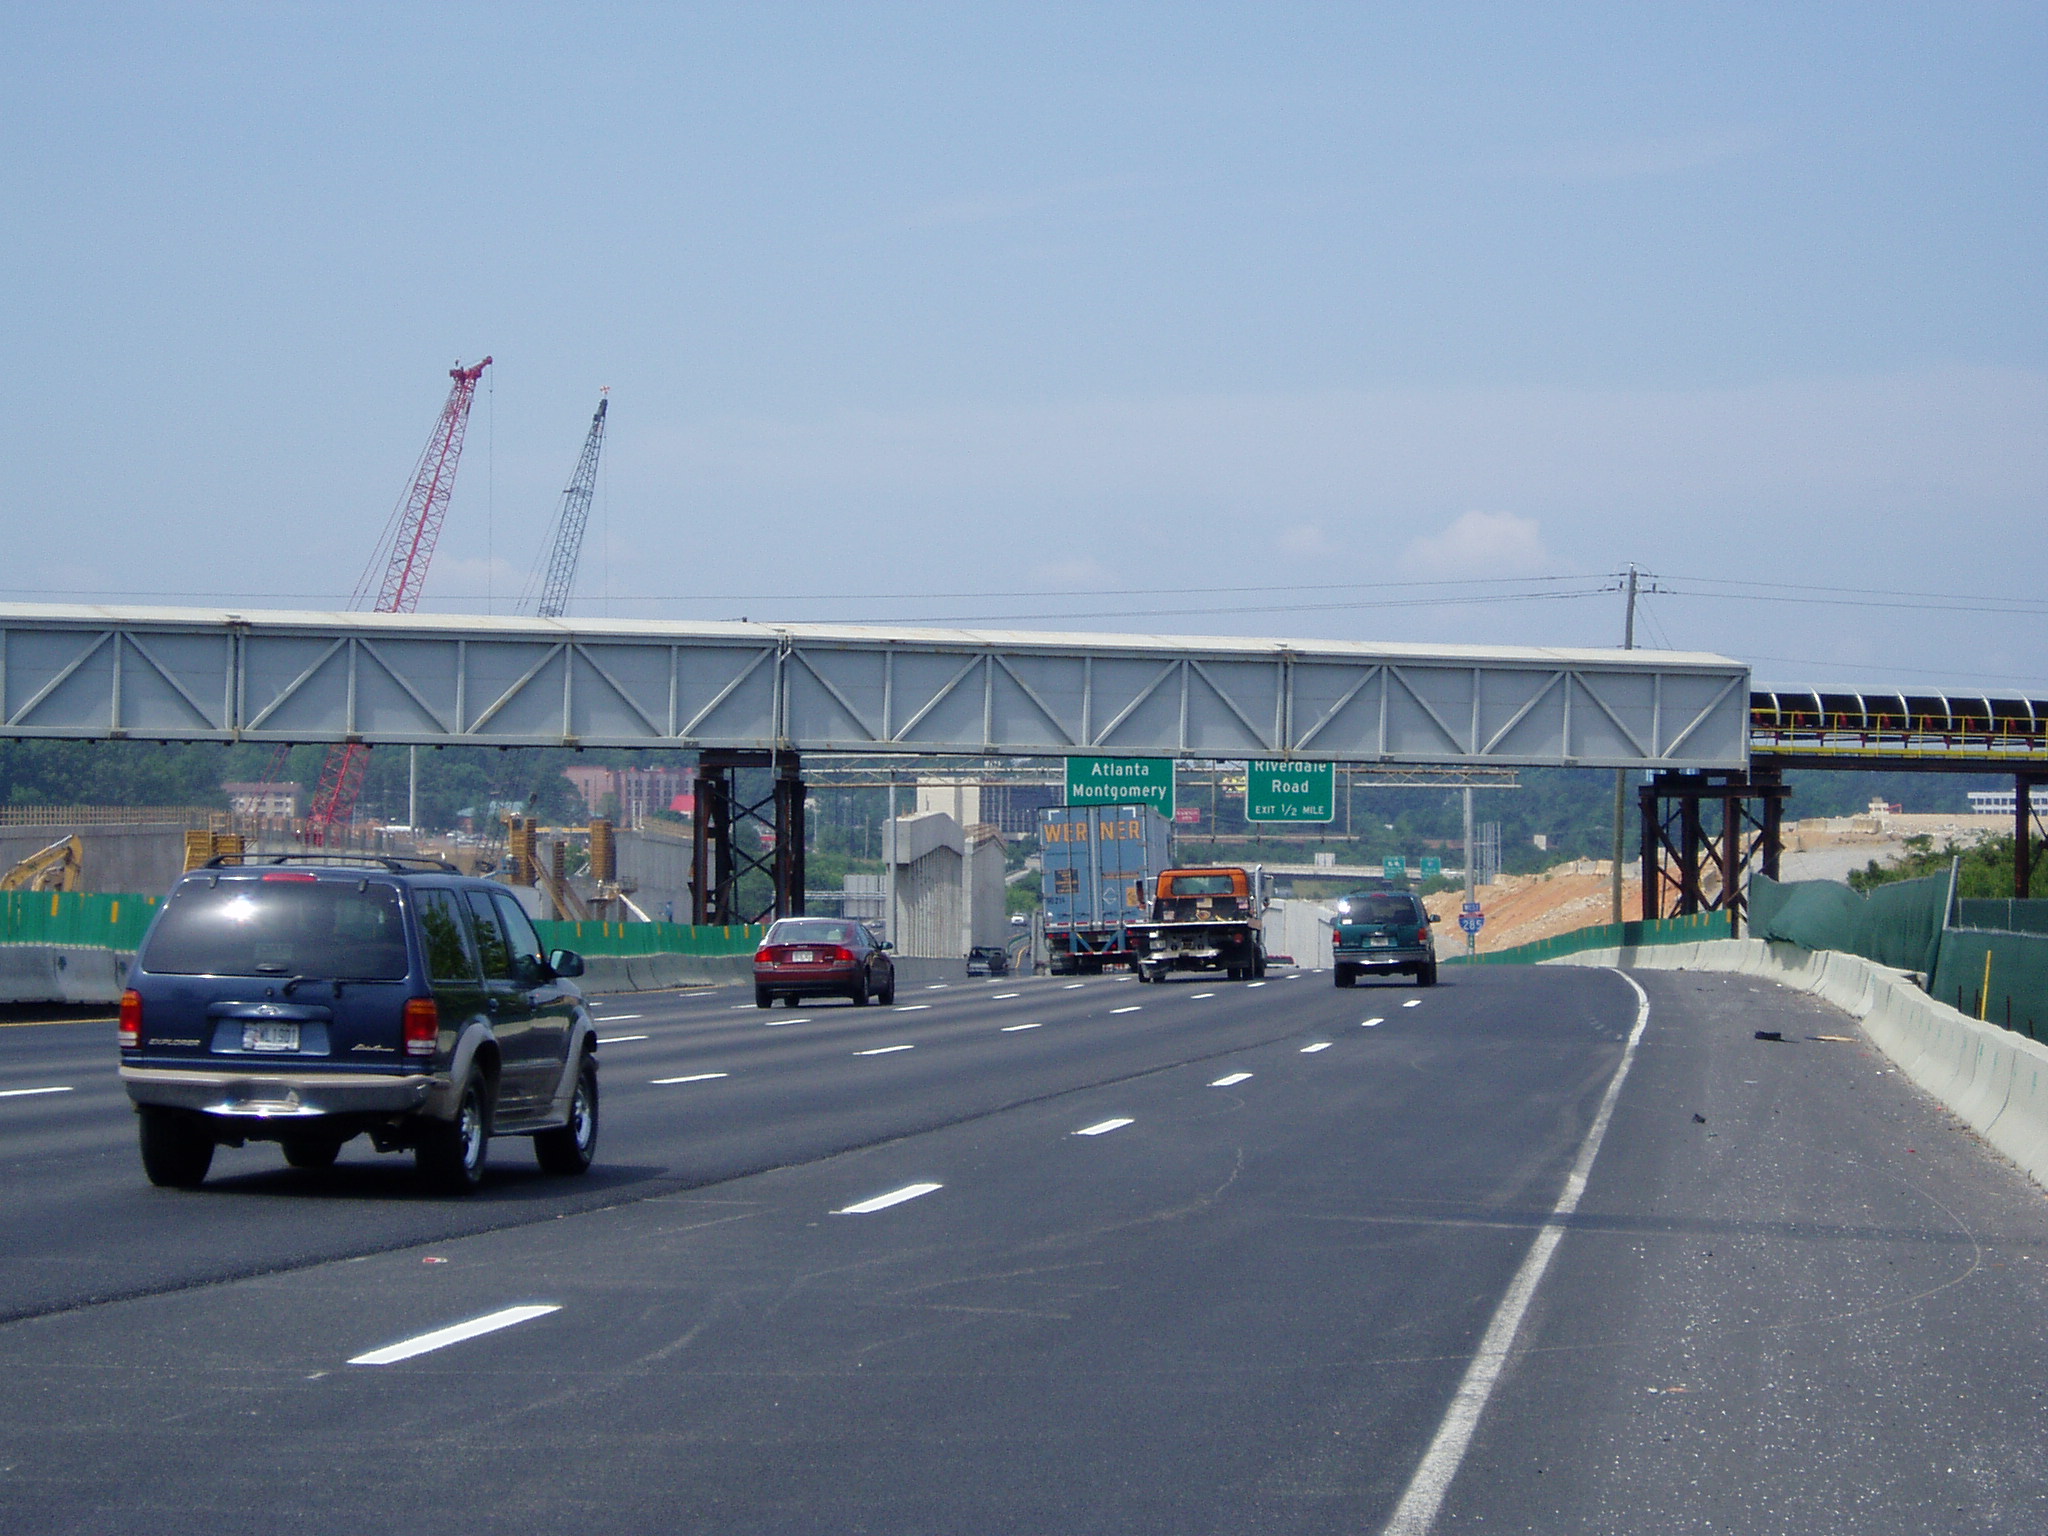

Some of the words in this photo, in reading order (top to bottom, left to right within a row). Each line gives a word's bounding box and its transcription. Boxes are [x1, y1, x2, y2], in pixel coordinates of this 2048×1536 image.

[1091, 762, 1149, 776] Atlanta
[1072, 783, 1167, 800] Montgomery
[1271, 779, 1309, 793] Road
[1255, 805, 1276, 814] EXIT
[1302, 805, 1325, 815] MILE
[1464, 919, 1482, 930] 285
